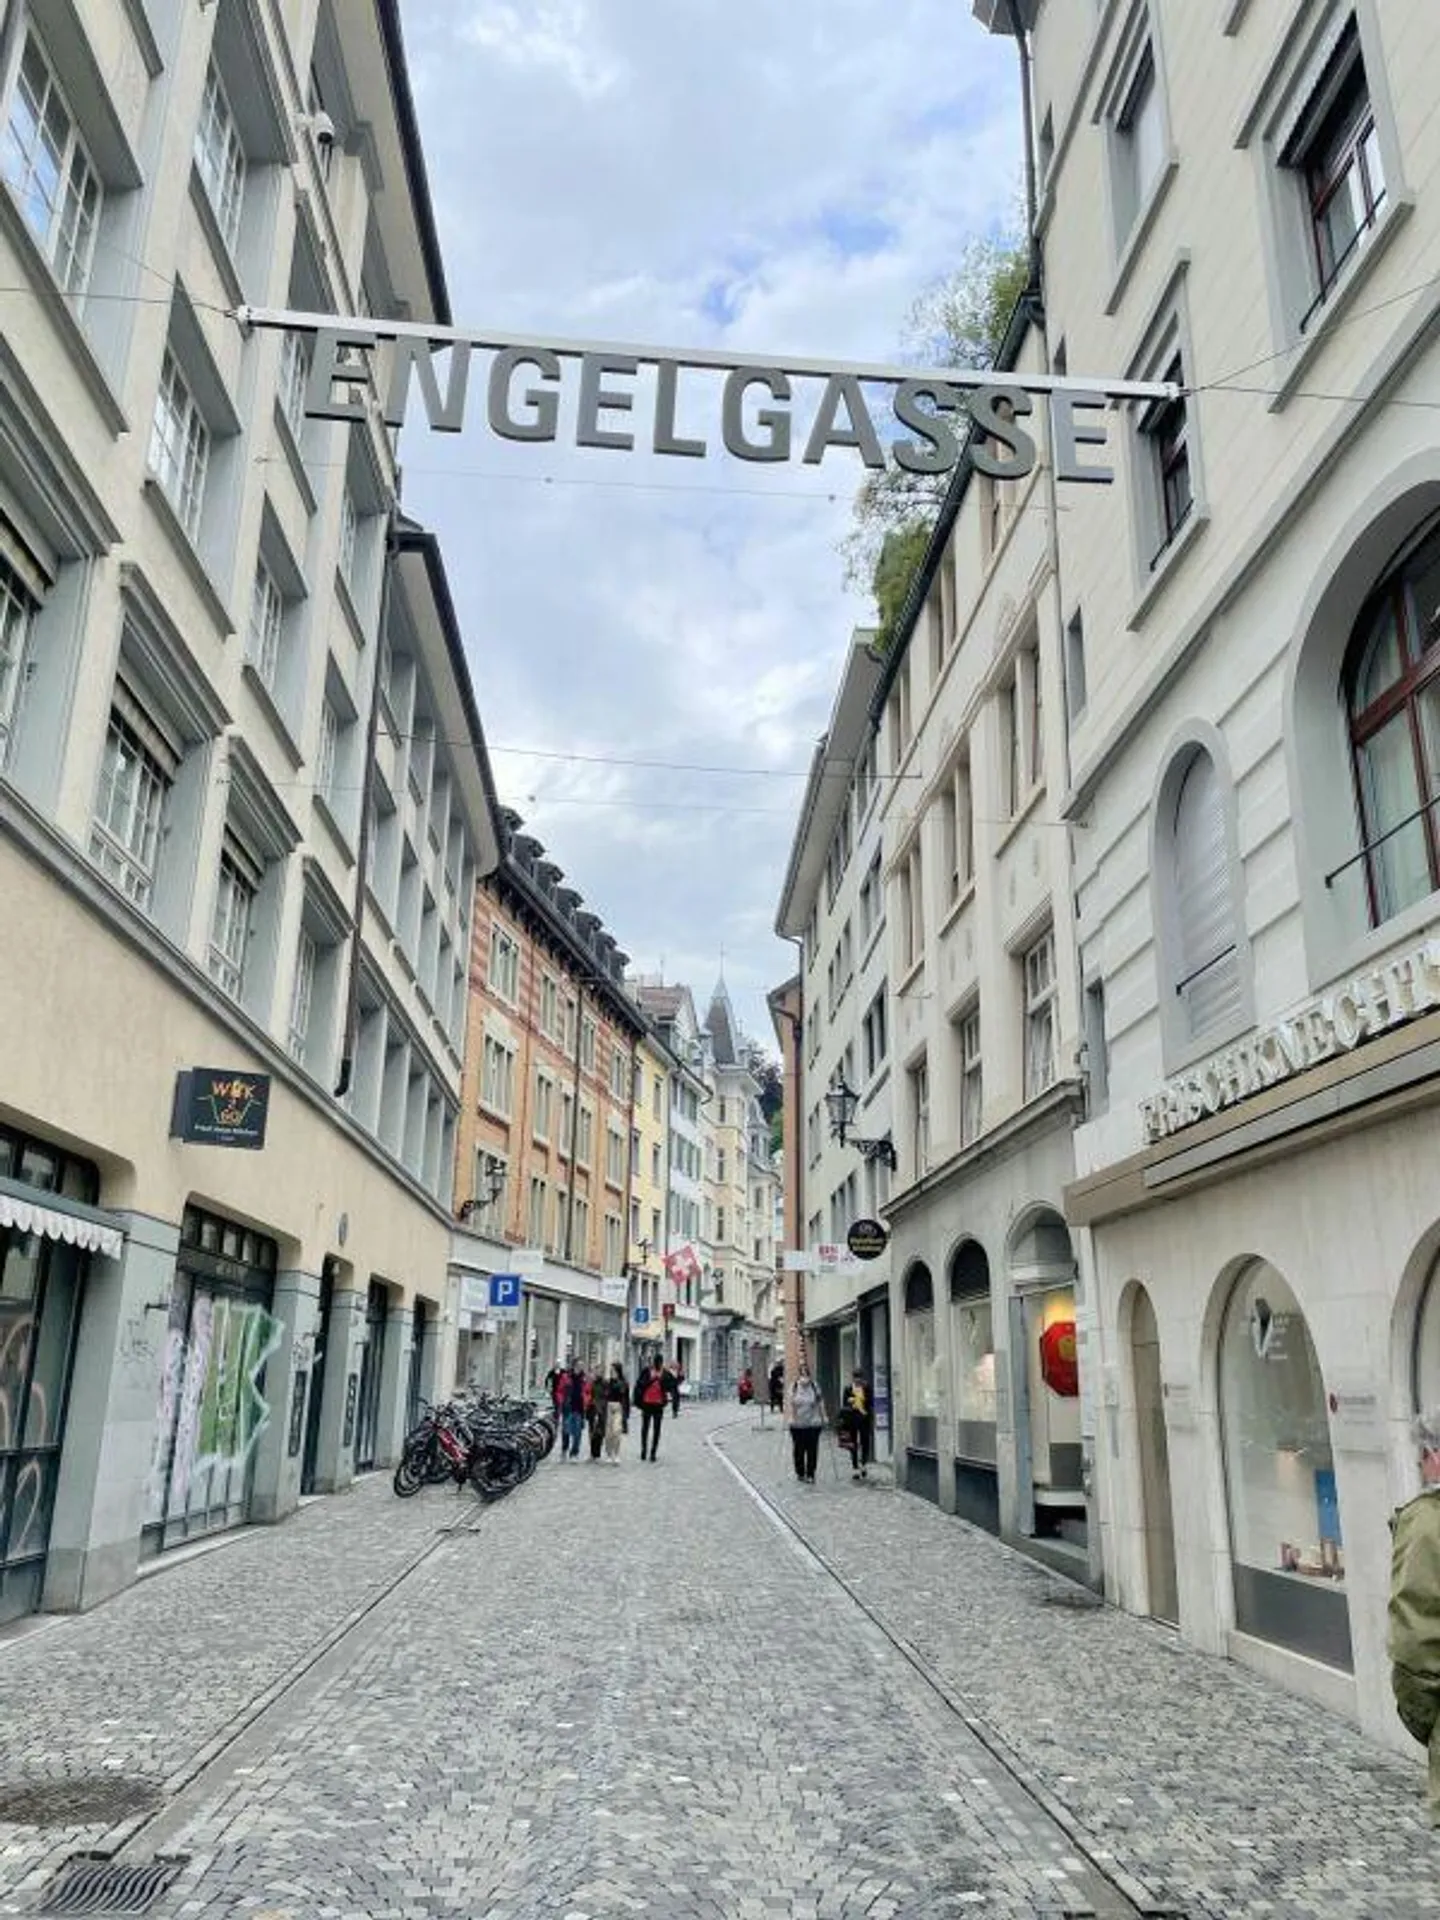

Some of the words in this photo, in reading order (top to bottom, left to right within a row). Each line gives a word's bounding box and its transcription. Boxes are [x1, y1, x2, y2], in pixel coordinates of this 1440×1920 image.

[305, 331, 1114, 485] ENGELGASSE
[211, 1080, 256, 1099] WOK
[498, 1280, 513, 1303] P
